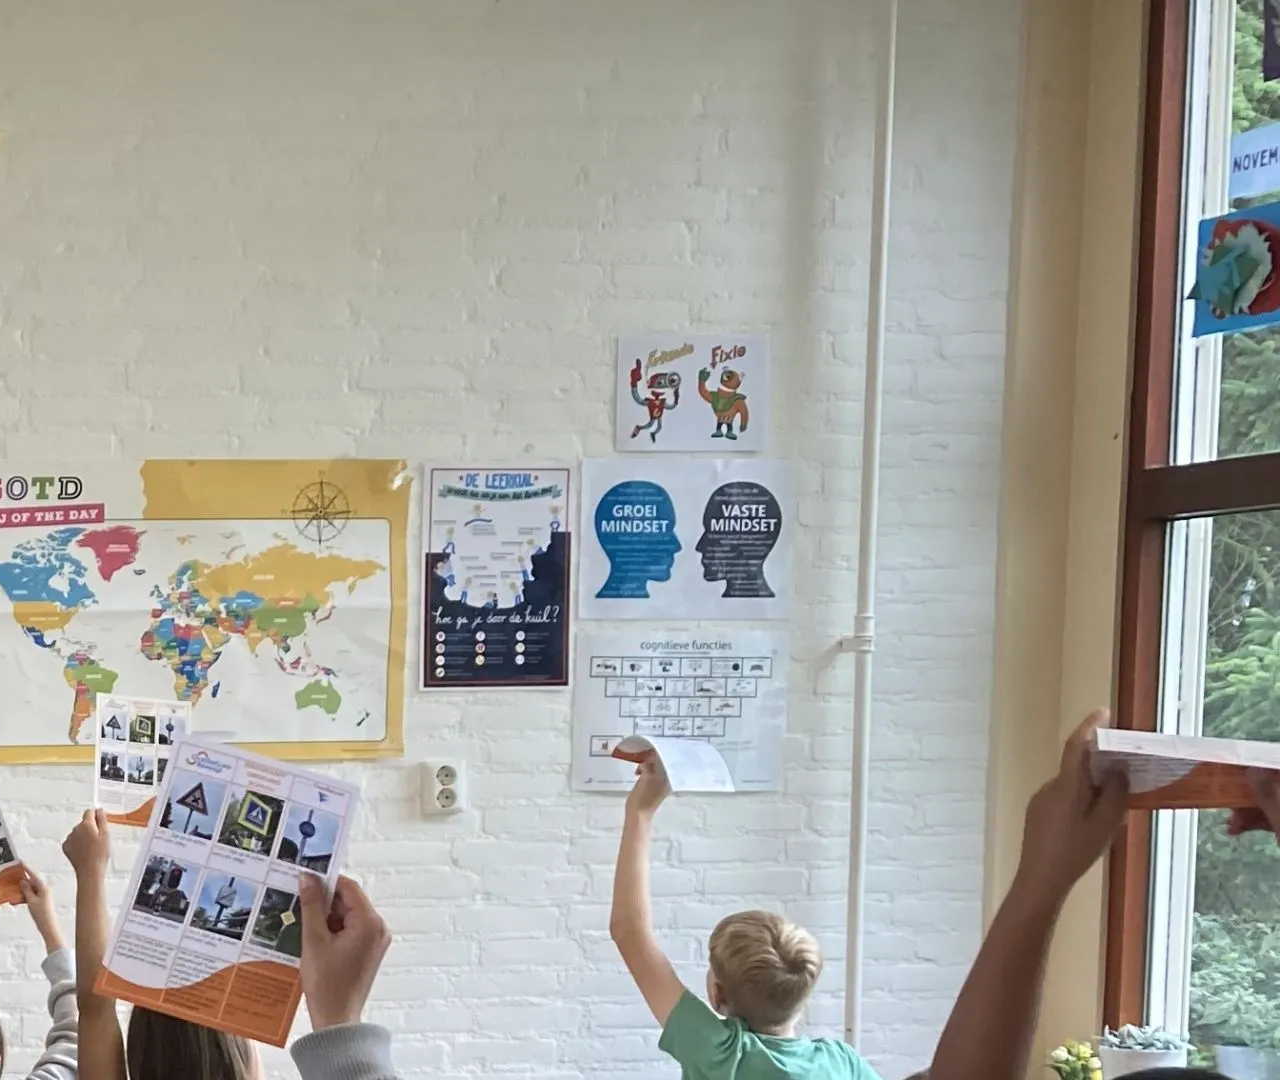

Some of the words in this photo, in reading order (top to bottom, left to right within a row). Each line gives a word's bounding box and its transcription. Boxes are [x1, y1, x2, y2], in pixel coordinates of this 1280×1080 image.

[1232, 146, 1278, 174] NOVEM
[11, 513, 30, 523] OF
[35, 511, 65, 522] THE
[69, 509, 99, 521] DAY
[612, 504, 657, 517] GROEI
[722, 504, 767, 517] VASTE
[601, 520, 669, 532] MINDSET
[710, 518, 778, 531] MINDSET
[432, 605, 452, 624] hoe
[457, 615, 468, 630] ga
[471, 612, 483, 629] je
[487, 611, 507, 624] door
[509, 611, 522, 624] de
[524, 605, 560, 624] kuil?
[640, 640, 689, 651] cognitieve
[692, 640, 732, 650] functies
